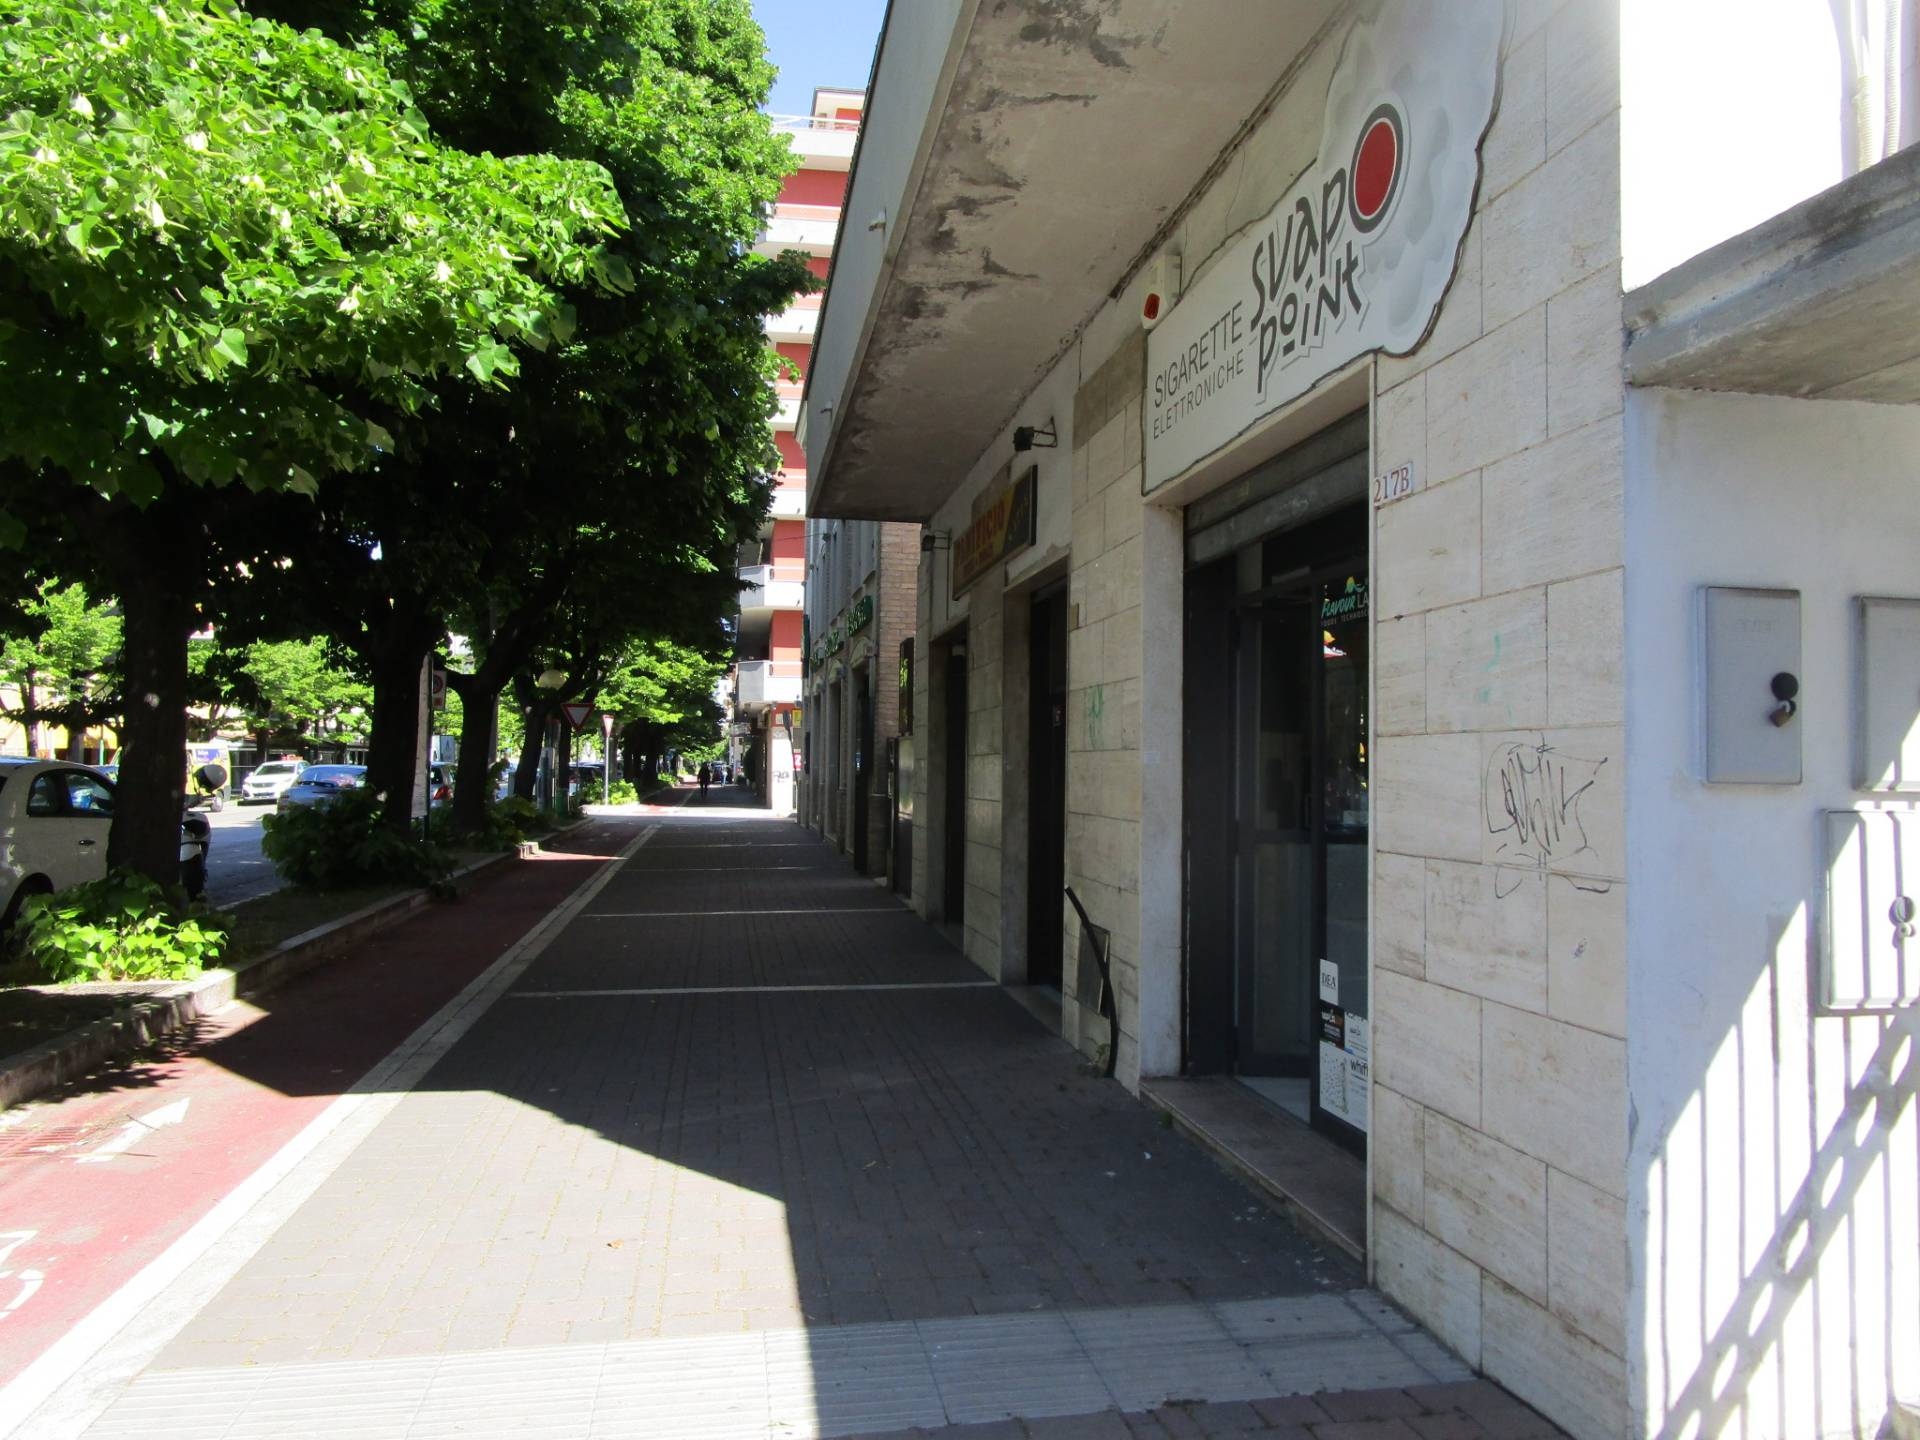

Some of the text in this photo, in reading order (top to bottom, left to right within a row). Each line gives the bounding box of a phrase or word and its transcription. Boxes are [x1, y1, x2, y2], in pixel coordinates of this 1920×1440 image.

[1154, 300, 1243, 408] SIGARETTE
[1152, 348, 1245, 441] ELETTRONICHE
[1373, 466, 1411, 503] 217B
[1321, 594, 1356, 619] FLAVOUR
